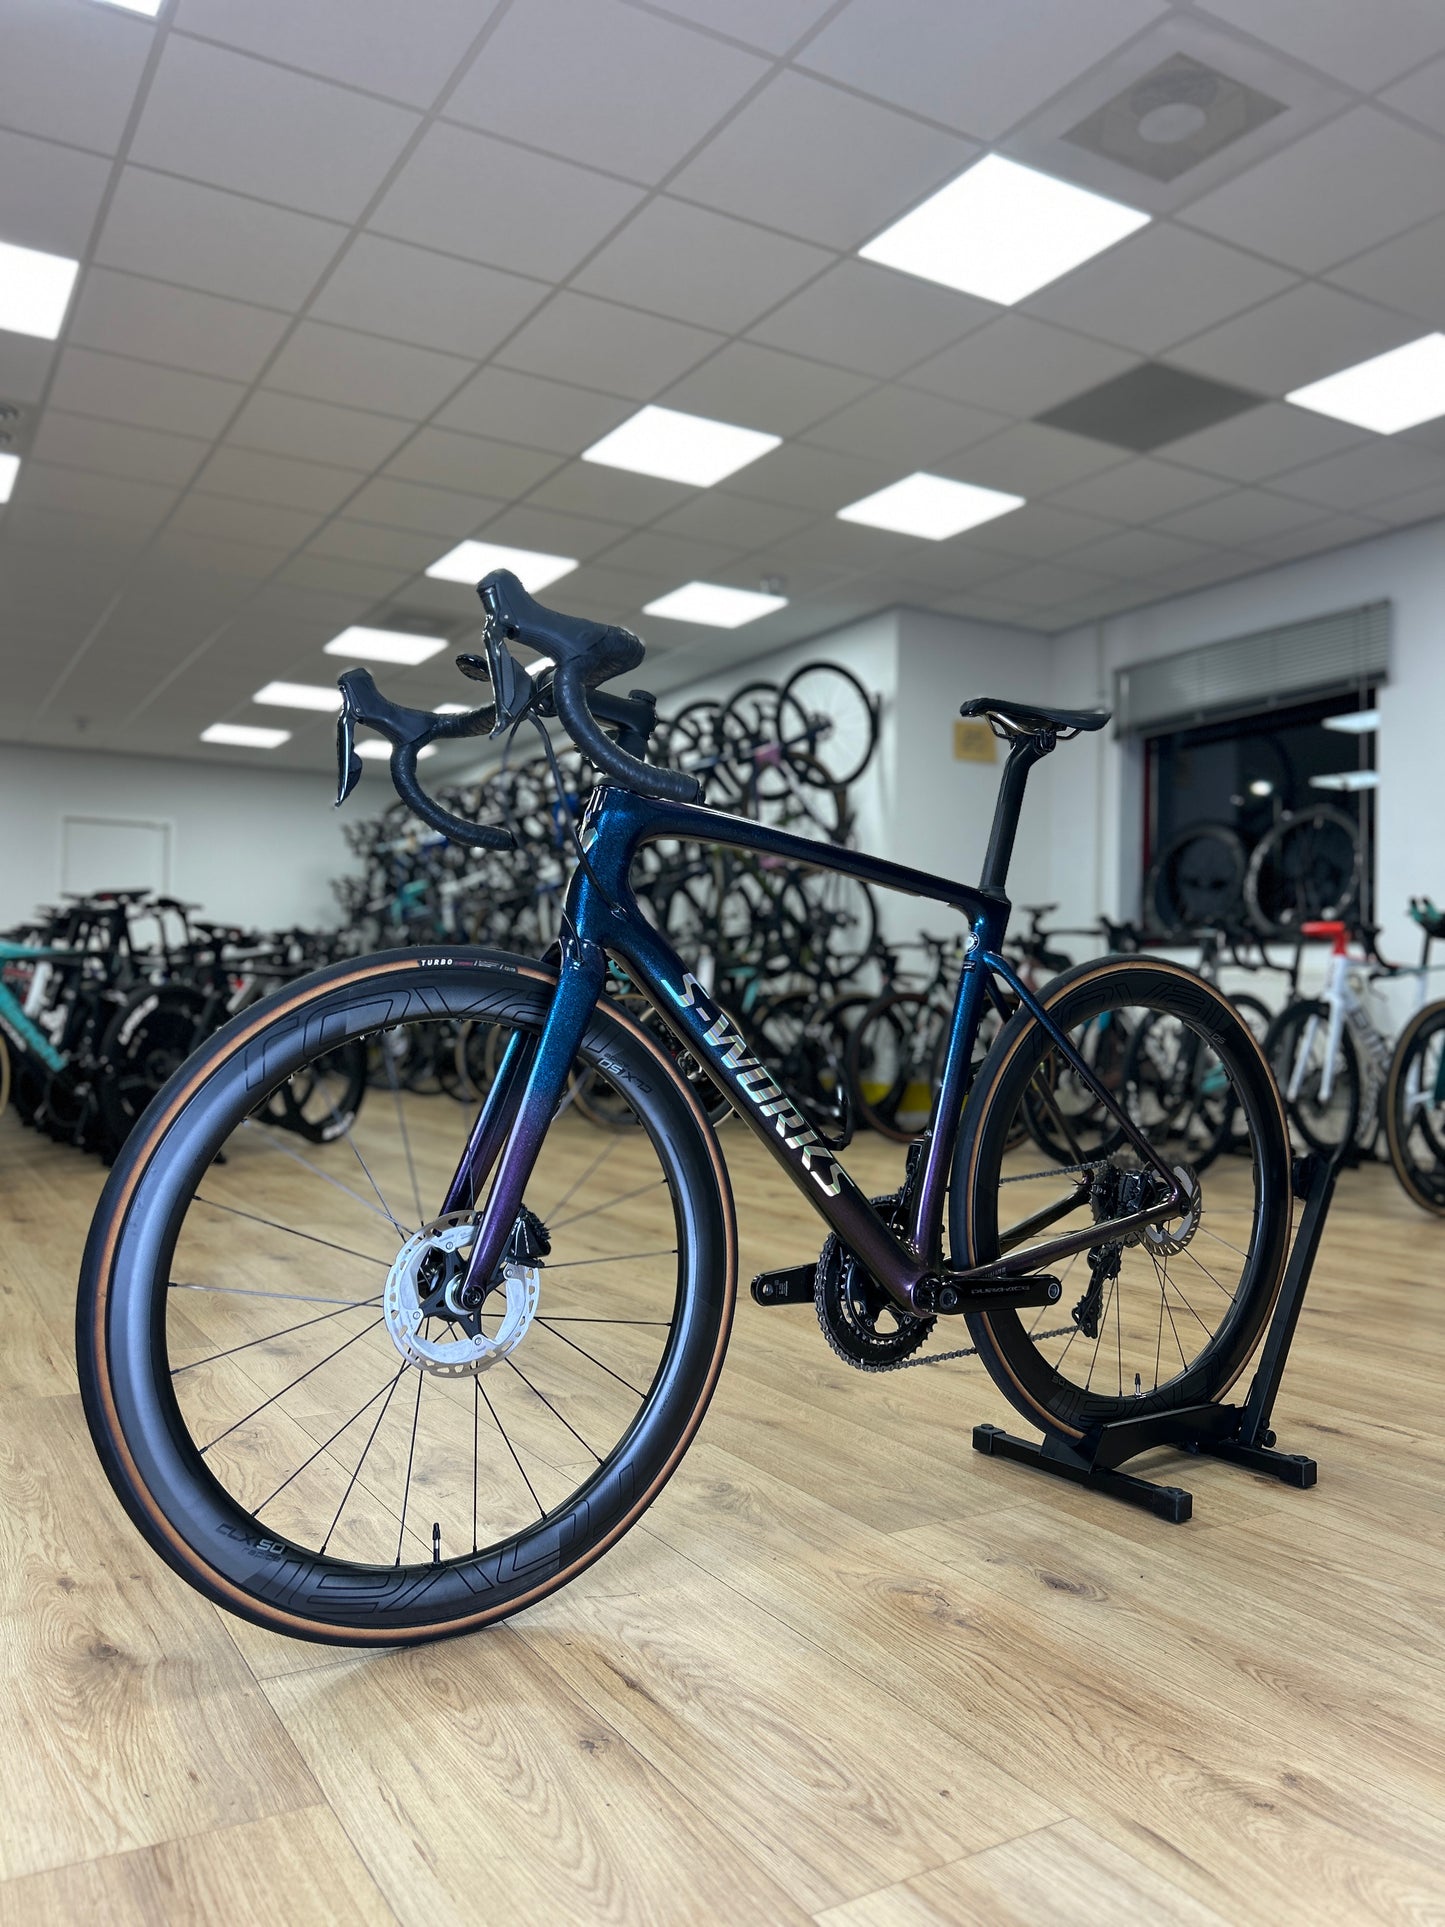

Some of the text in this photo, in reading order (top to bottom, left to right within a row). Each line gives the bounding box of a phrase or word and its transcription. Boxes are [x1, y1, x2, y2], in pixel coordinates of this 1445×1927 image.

[421, 958, 453, 967] TURBO
[598, 1058, 623, 1076] 50
[660, 972, 855, 1198] S-WORKS
[215, 1522, 286, 1555] CLX 50
